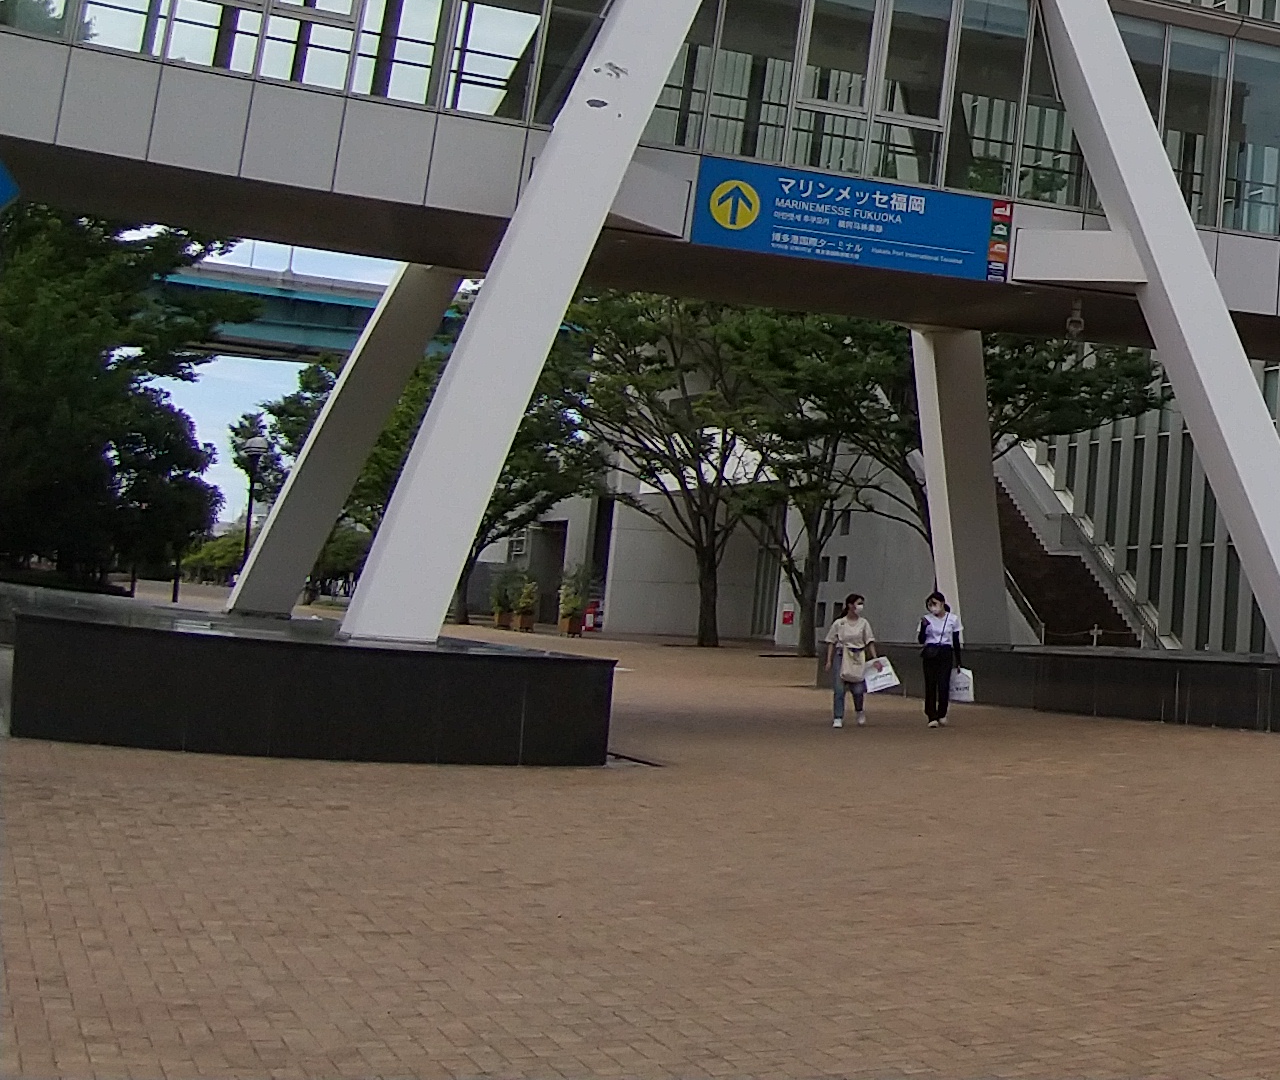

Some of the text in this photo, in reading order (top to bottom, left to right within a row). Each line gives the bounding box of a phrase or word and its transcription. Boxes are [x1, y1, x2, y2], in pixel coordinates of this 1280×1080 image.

[775, 197, 903, 224] MARINEMESSE FUKUOKA
[778, 177, 926, 215] マリンメッセ福岡
